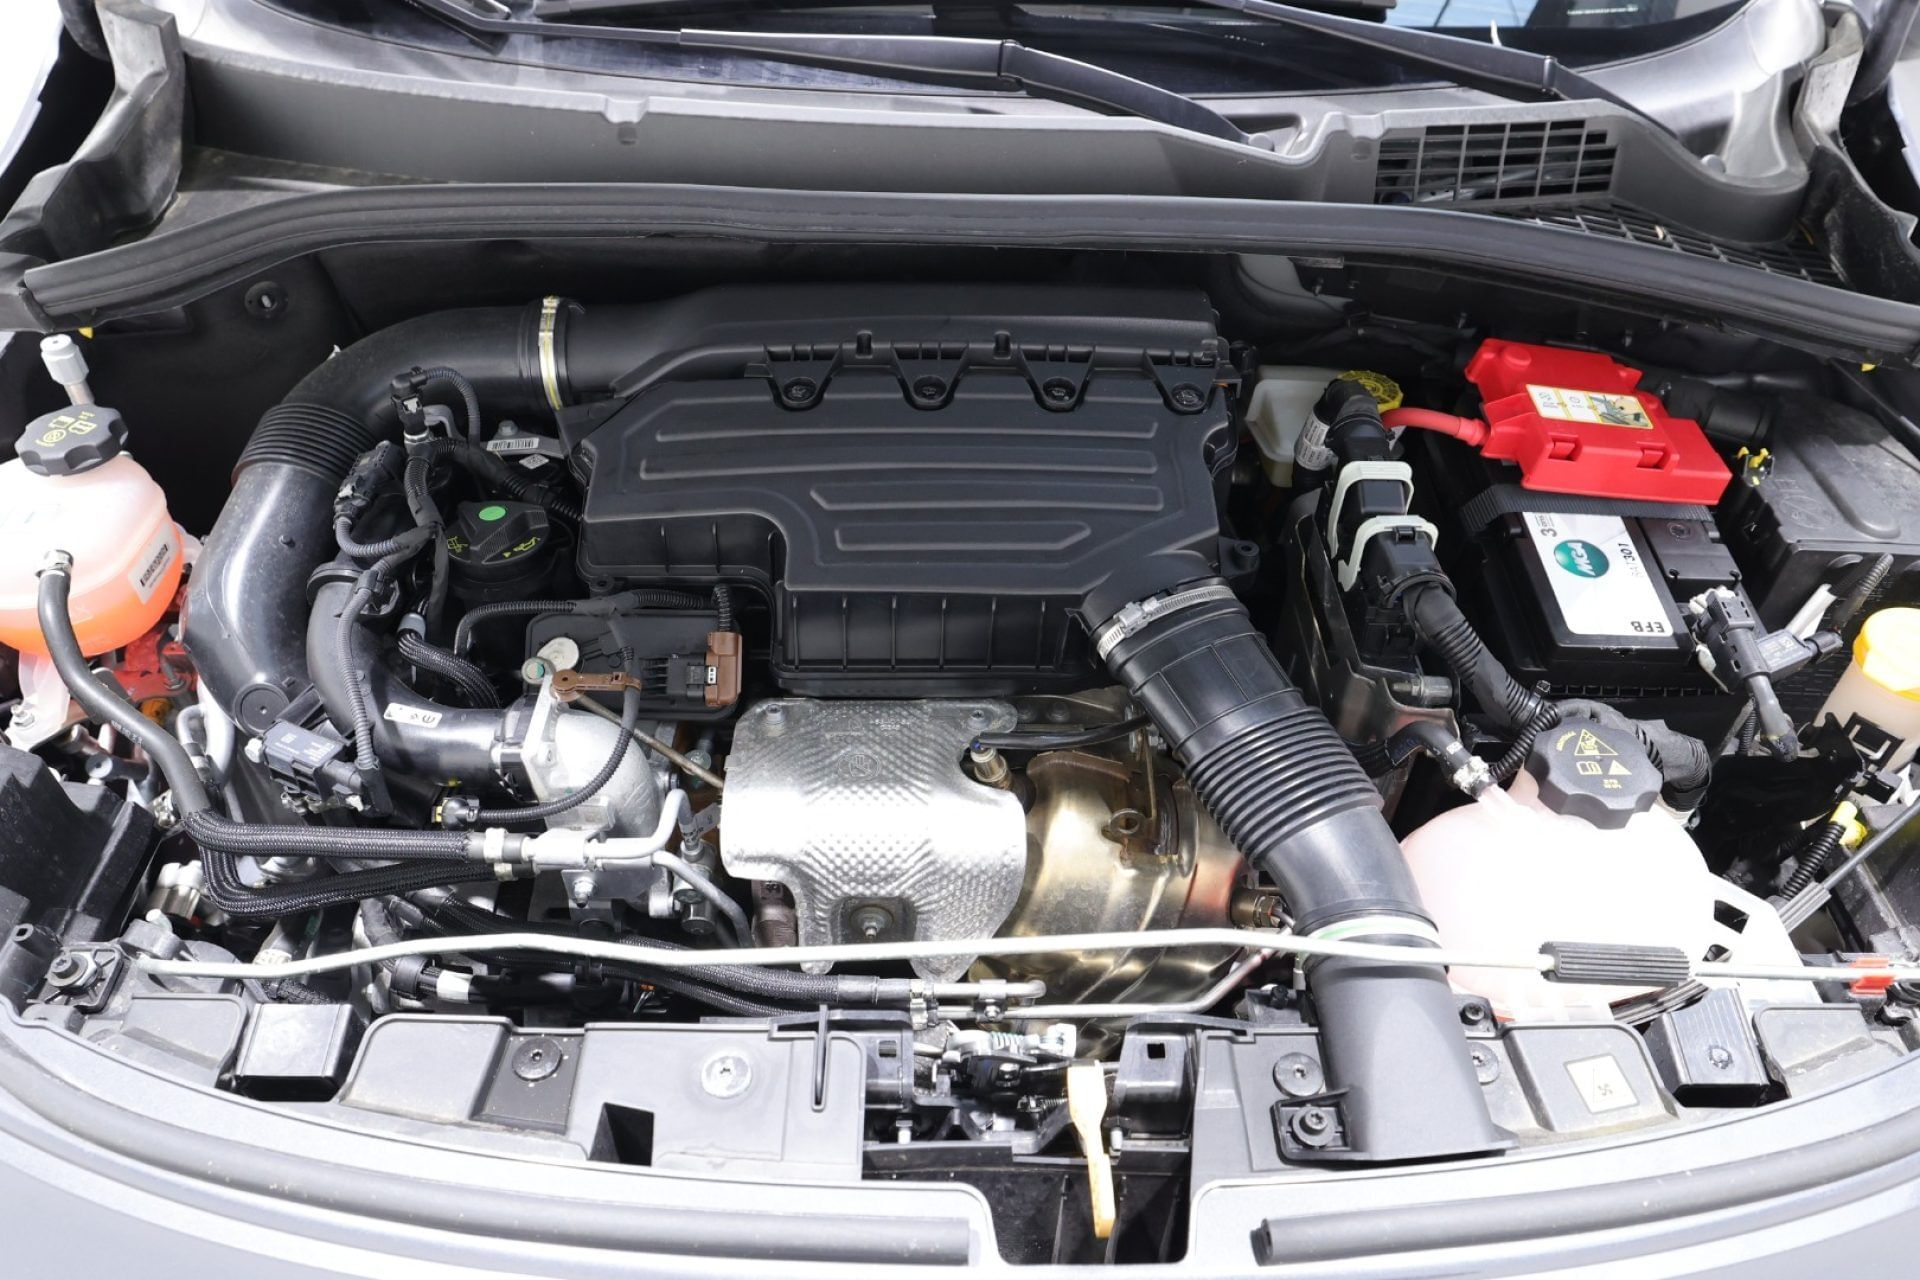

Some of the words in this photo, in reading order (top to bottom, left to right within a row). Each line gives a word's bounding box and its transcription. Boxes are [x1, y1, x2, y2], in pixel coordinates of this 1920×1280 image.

[1540, 528, 1557, 537] 3
[1566, 542, 1597, 577] MGA
[1631, 621, 1665, 633] EFB
